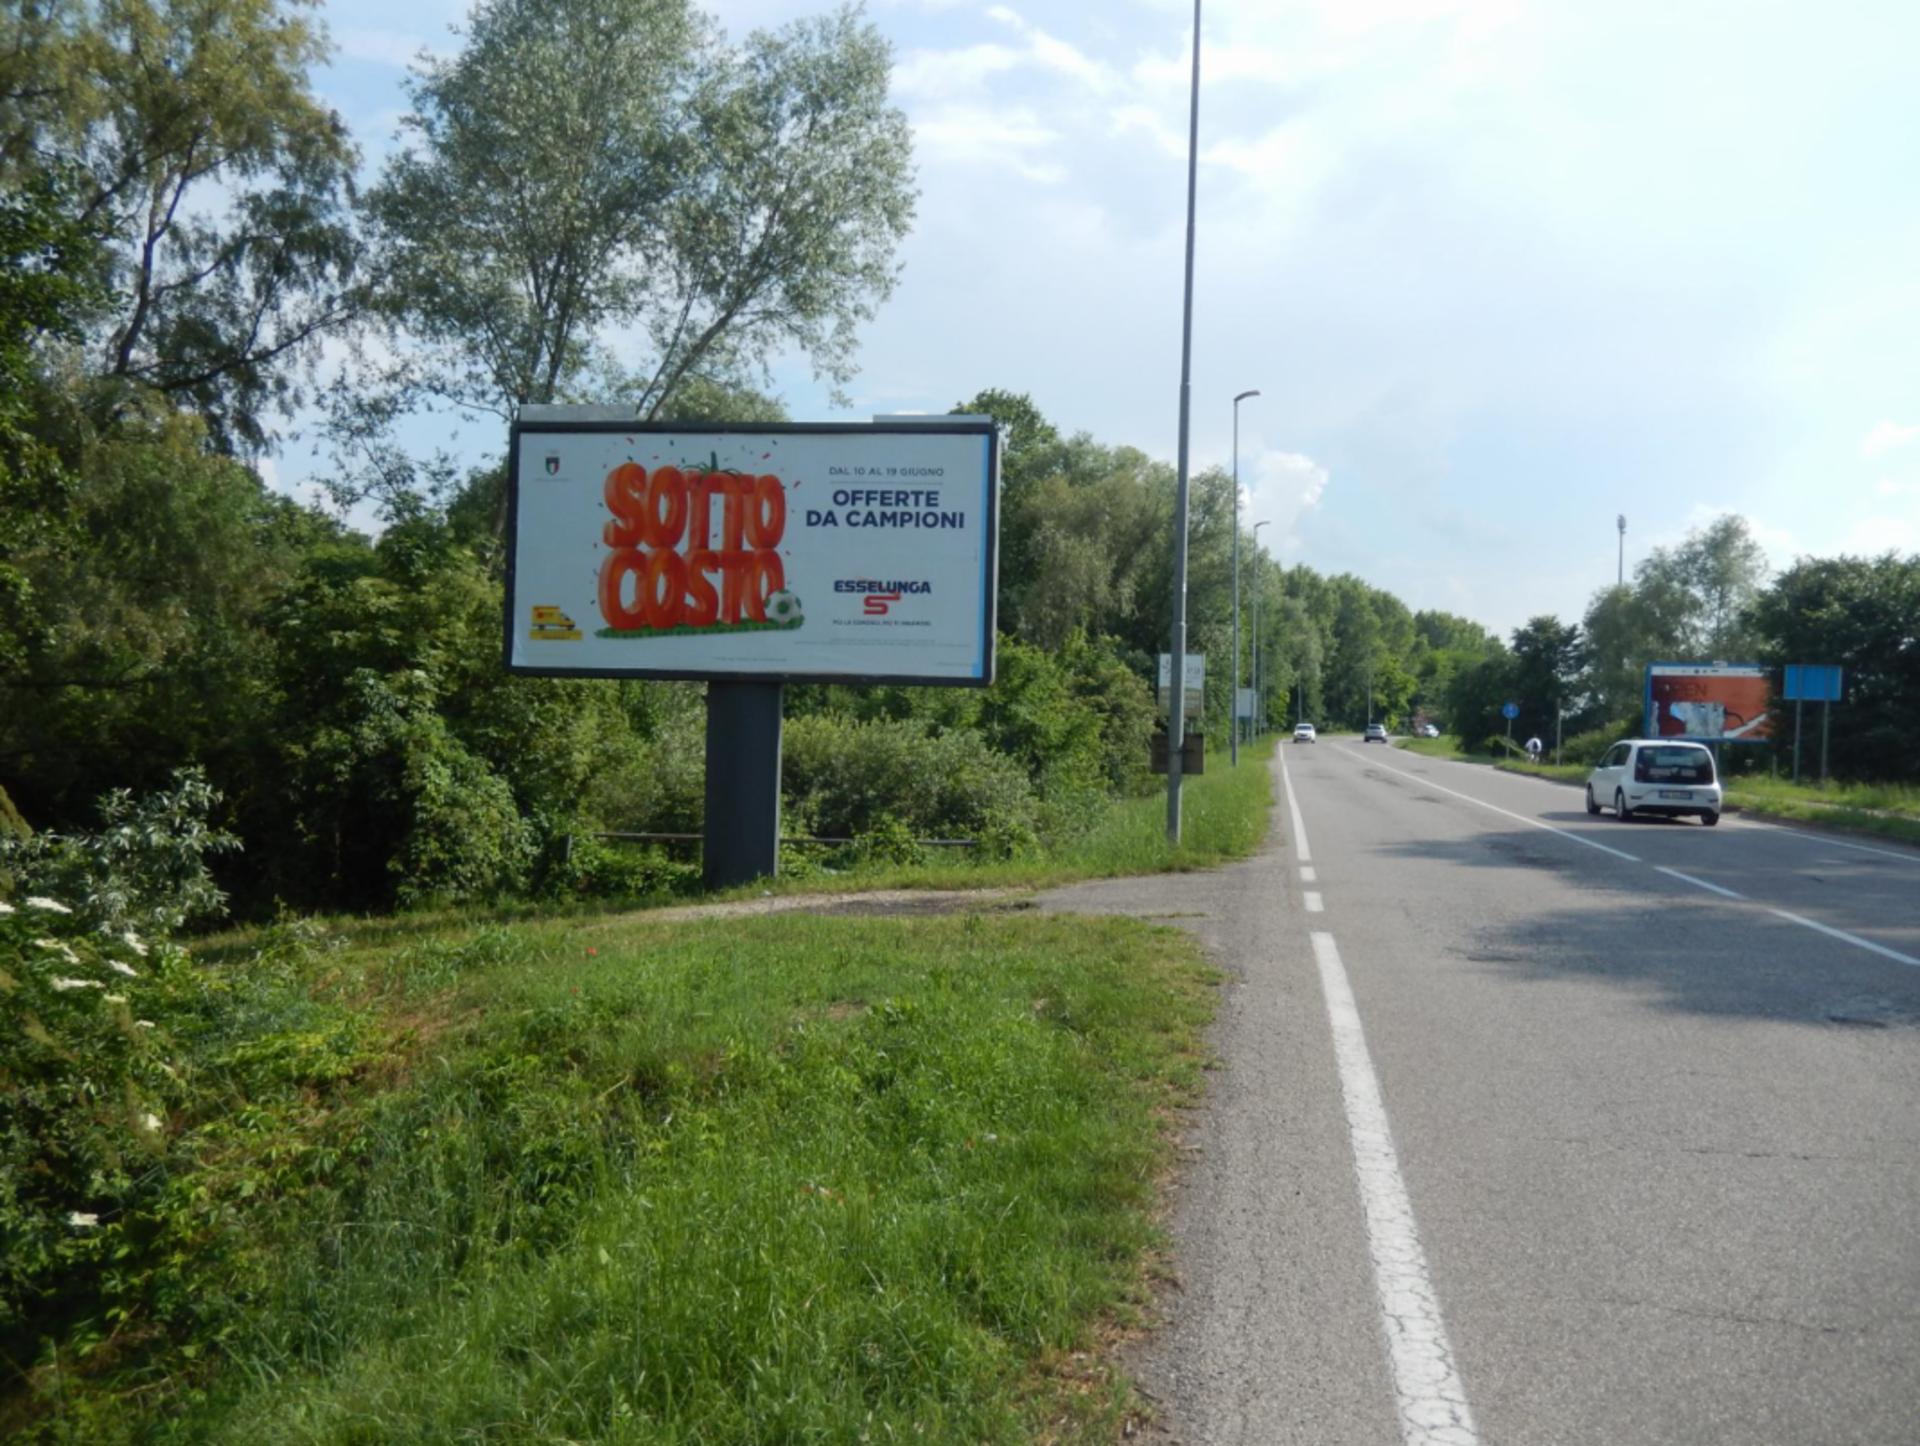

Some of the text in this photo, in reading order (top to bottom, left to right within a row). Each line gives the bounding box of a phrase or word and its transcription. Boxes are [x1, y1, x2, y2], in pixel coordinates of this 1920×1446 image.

[829, 466, 944, 477] DAL 10 AL 19 GIUGNO
[604, 462, 786, 549] SOTTO
[832, 489, 940, 508] OFFERTE
[806, 510, 965, 529] DA CAMPIONI
[600, 546, 786, 630] COSTO
[834, 580, 931, 594] ESSELUNGA
